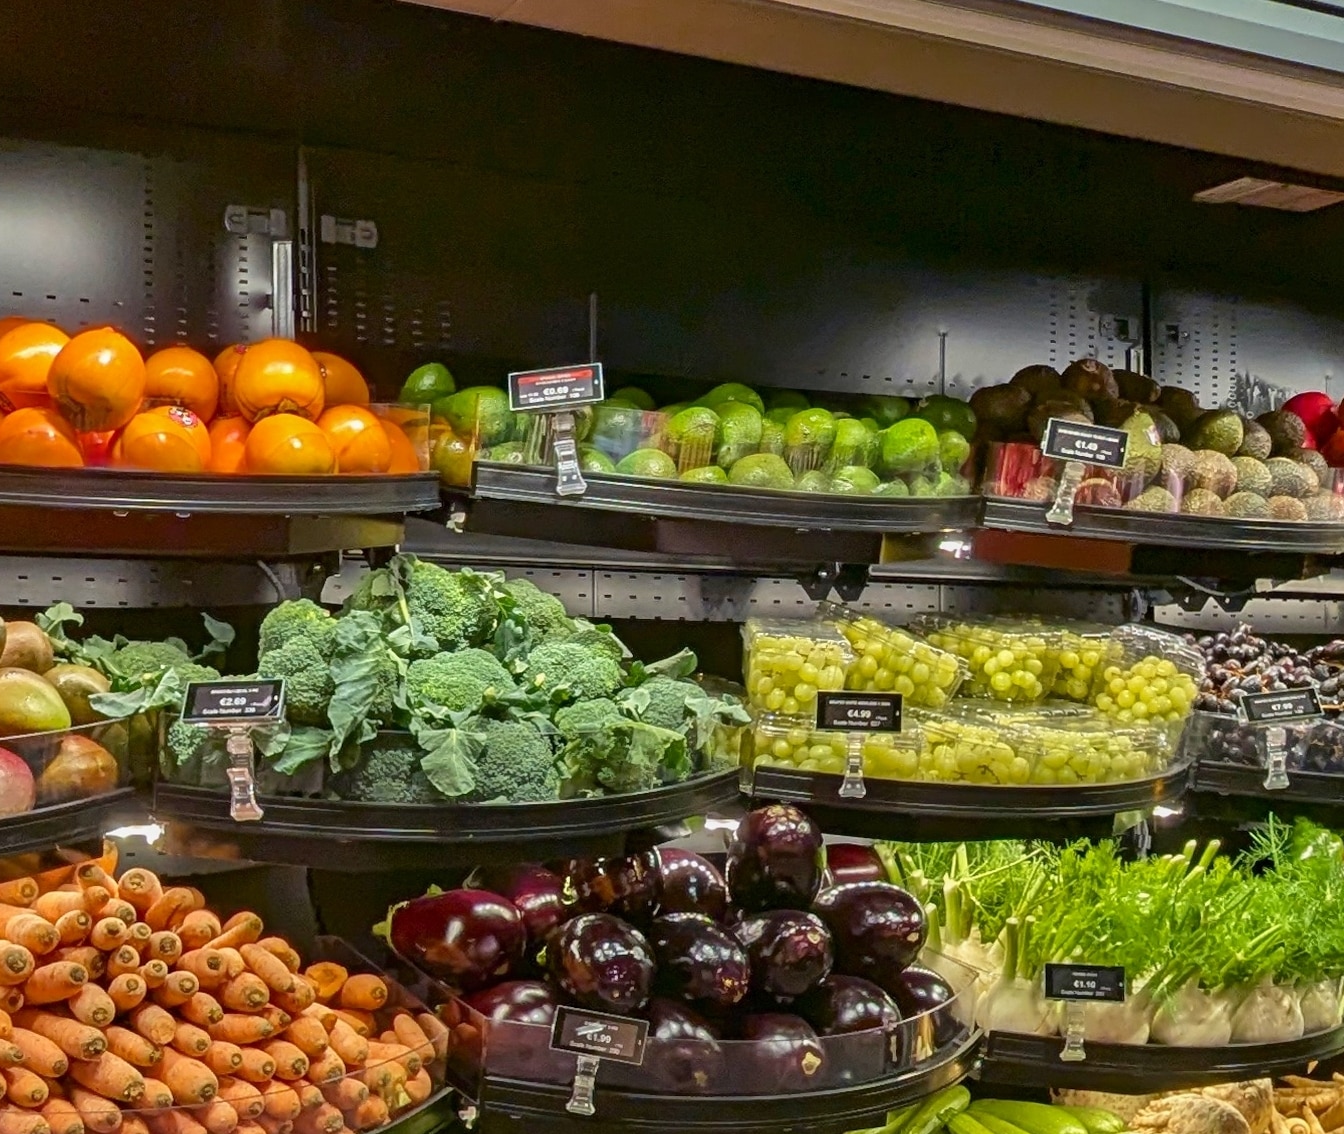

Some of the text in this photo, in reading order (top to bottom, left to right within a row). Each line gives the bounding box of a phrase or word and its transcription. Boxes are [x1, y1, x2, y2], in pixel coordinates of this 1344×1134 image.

[543, 386, 569, 396] €0.69
[848, 710, 871, 719] €4.99
[587, 1033, 611, 1044] €1.99
